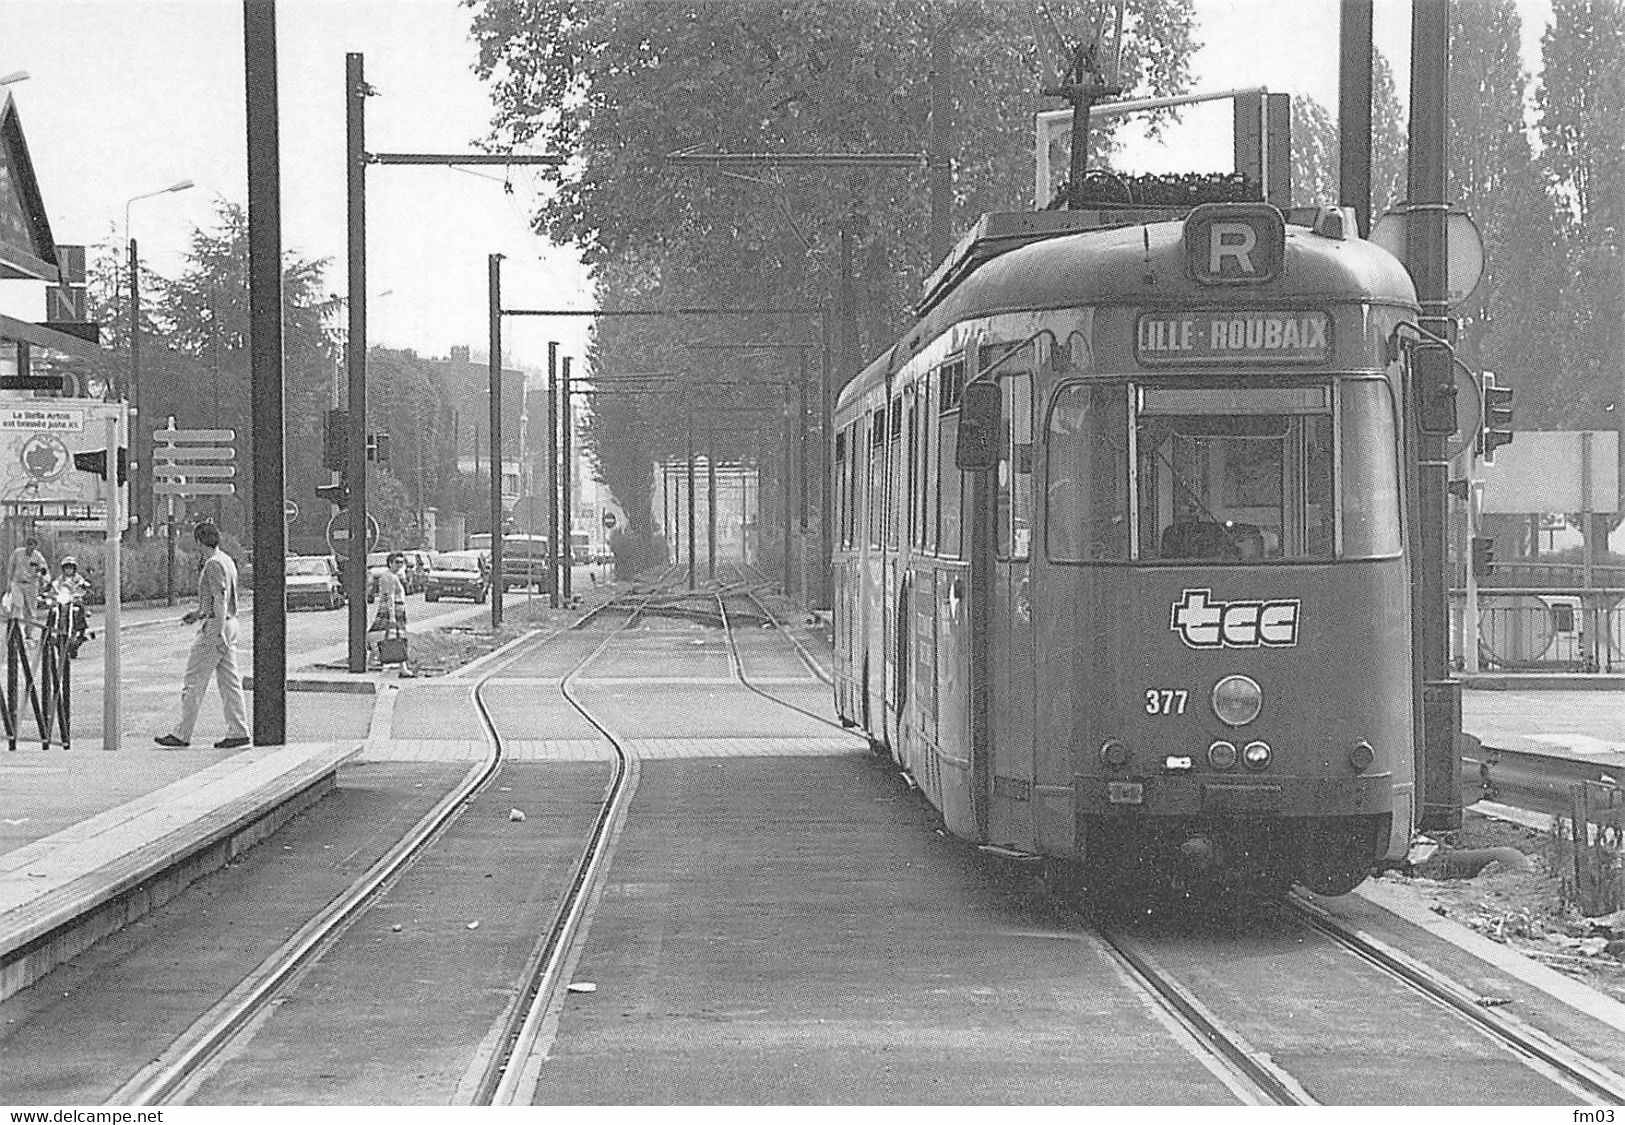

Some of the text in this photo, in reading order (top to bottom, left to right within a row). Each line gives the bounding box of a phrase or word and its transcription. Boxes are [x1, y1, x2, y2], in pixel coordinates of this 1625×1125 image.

[1208, 223, 1257, 273] R
[1137, 320, 1195, 351] LILLE
[1210, 318, 1329, 350] ROUBAIX
[1145, 689, 1188, 714] 377
